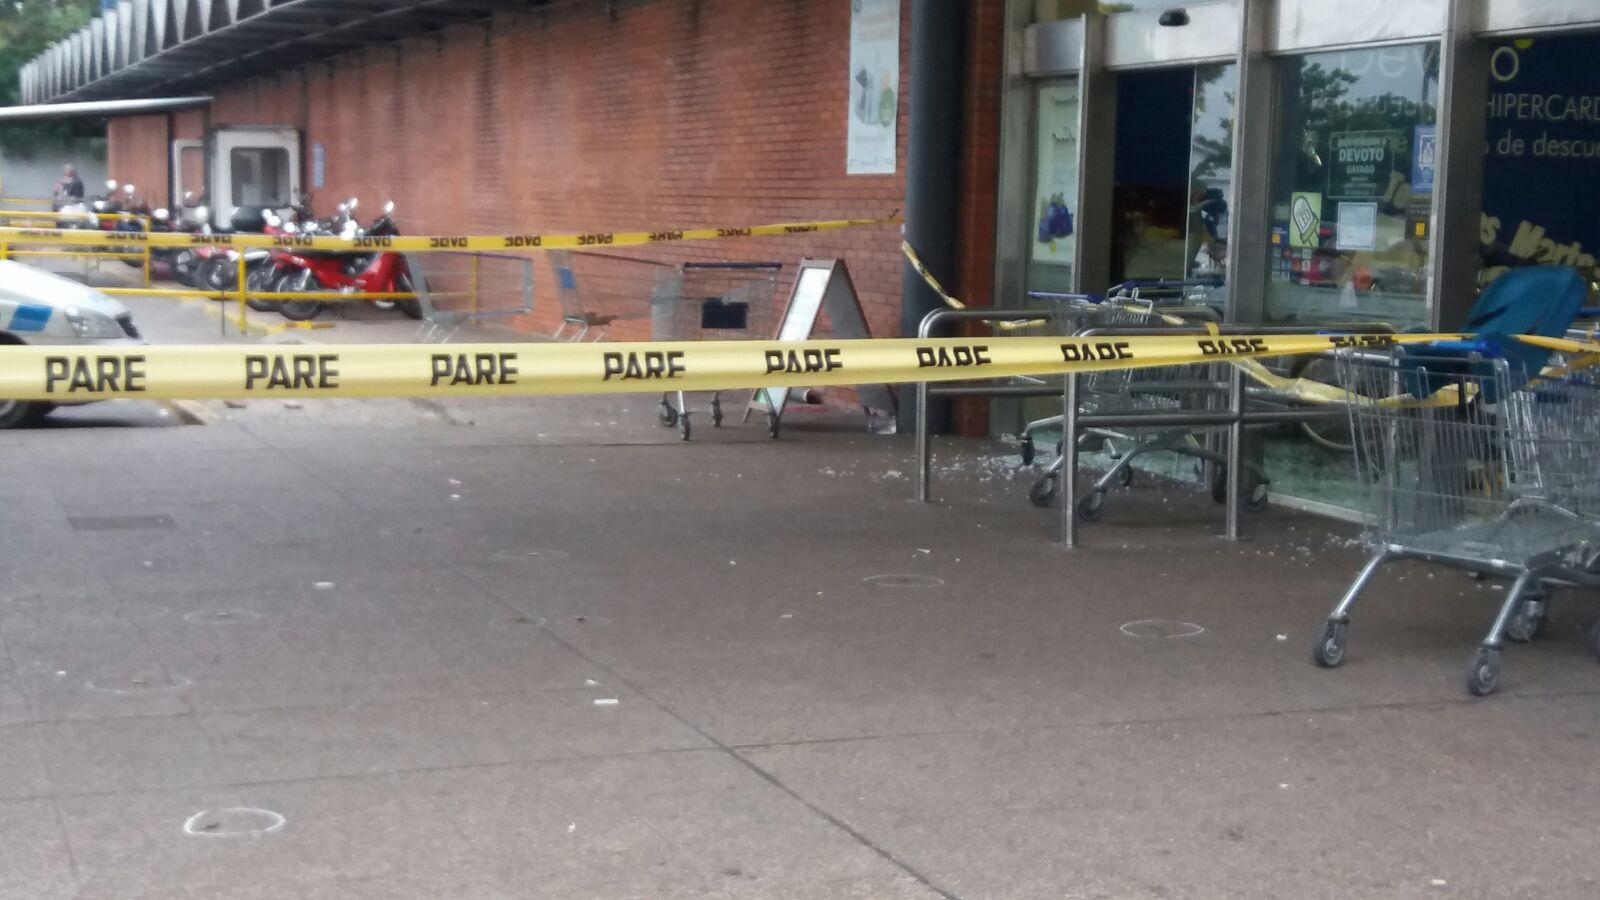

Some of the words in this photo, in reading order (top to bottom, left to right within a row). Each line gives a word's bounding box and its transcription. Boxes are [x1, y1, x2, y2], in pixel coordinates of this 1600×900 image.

[1339, 148, 1384, 162] DEVOTO
[1498, 129, 1525, 155] de
[46, 355, 146, 393] PARE
[245, 354, 339, 390] PARE
[430, 353, 518, 387] PARE
[603, 351, 685, 381] PARE
[765, 348, 844, 374] PARE
